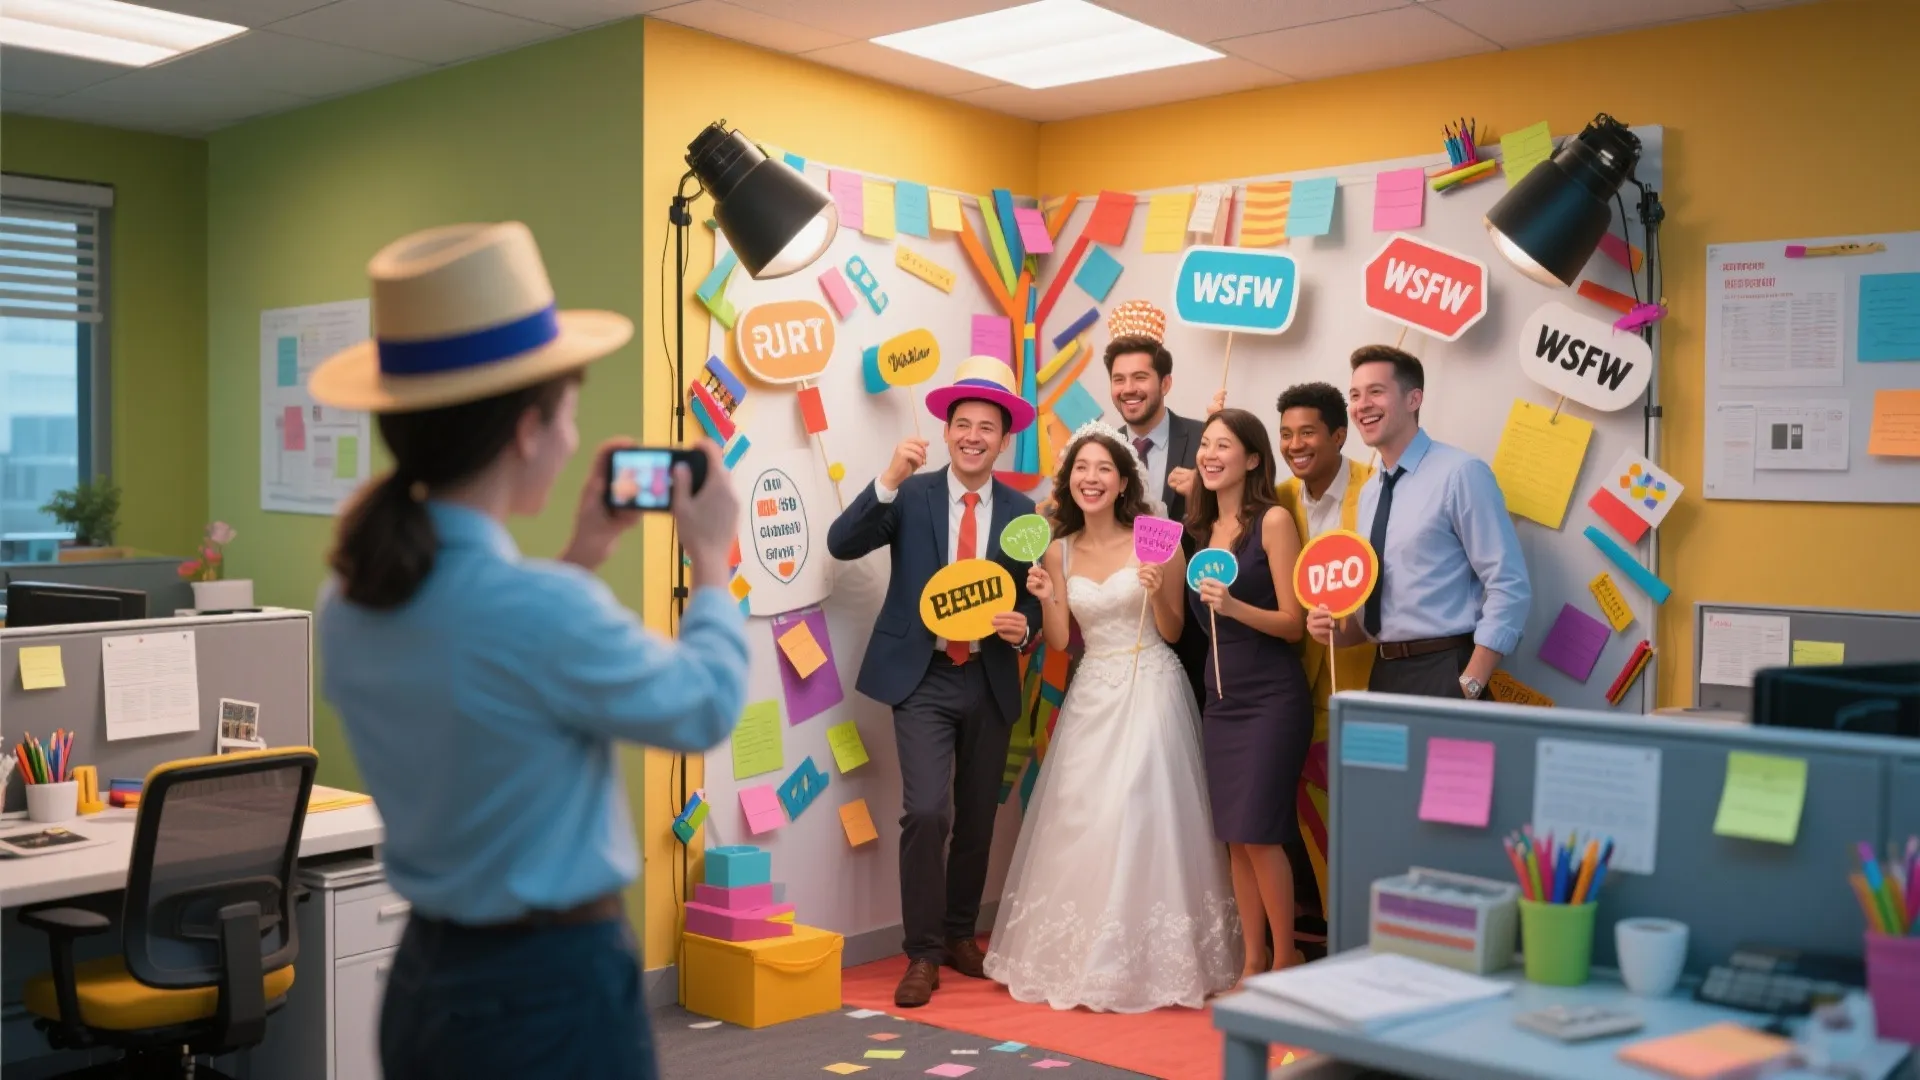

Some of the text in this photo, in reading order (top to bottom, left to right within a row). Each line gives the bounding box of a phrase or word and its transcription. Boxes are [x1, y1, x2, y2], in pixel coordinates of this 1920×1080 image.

[1193, 271, 1283, 309] WSFW
[1383, 257, 1474, 316] WSFW
[1535, 323, 1634, 392] WSFW
[1308, 555, 1364, 595] DEO
